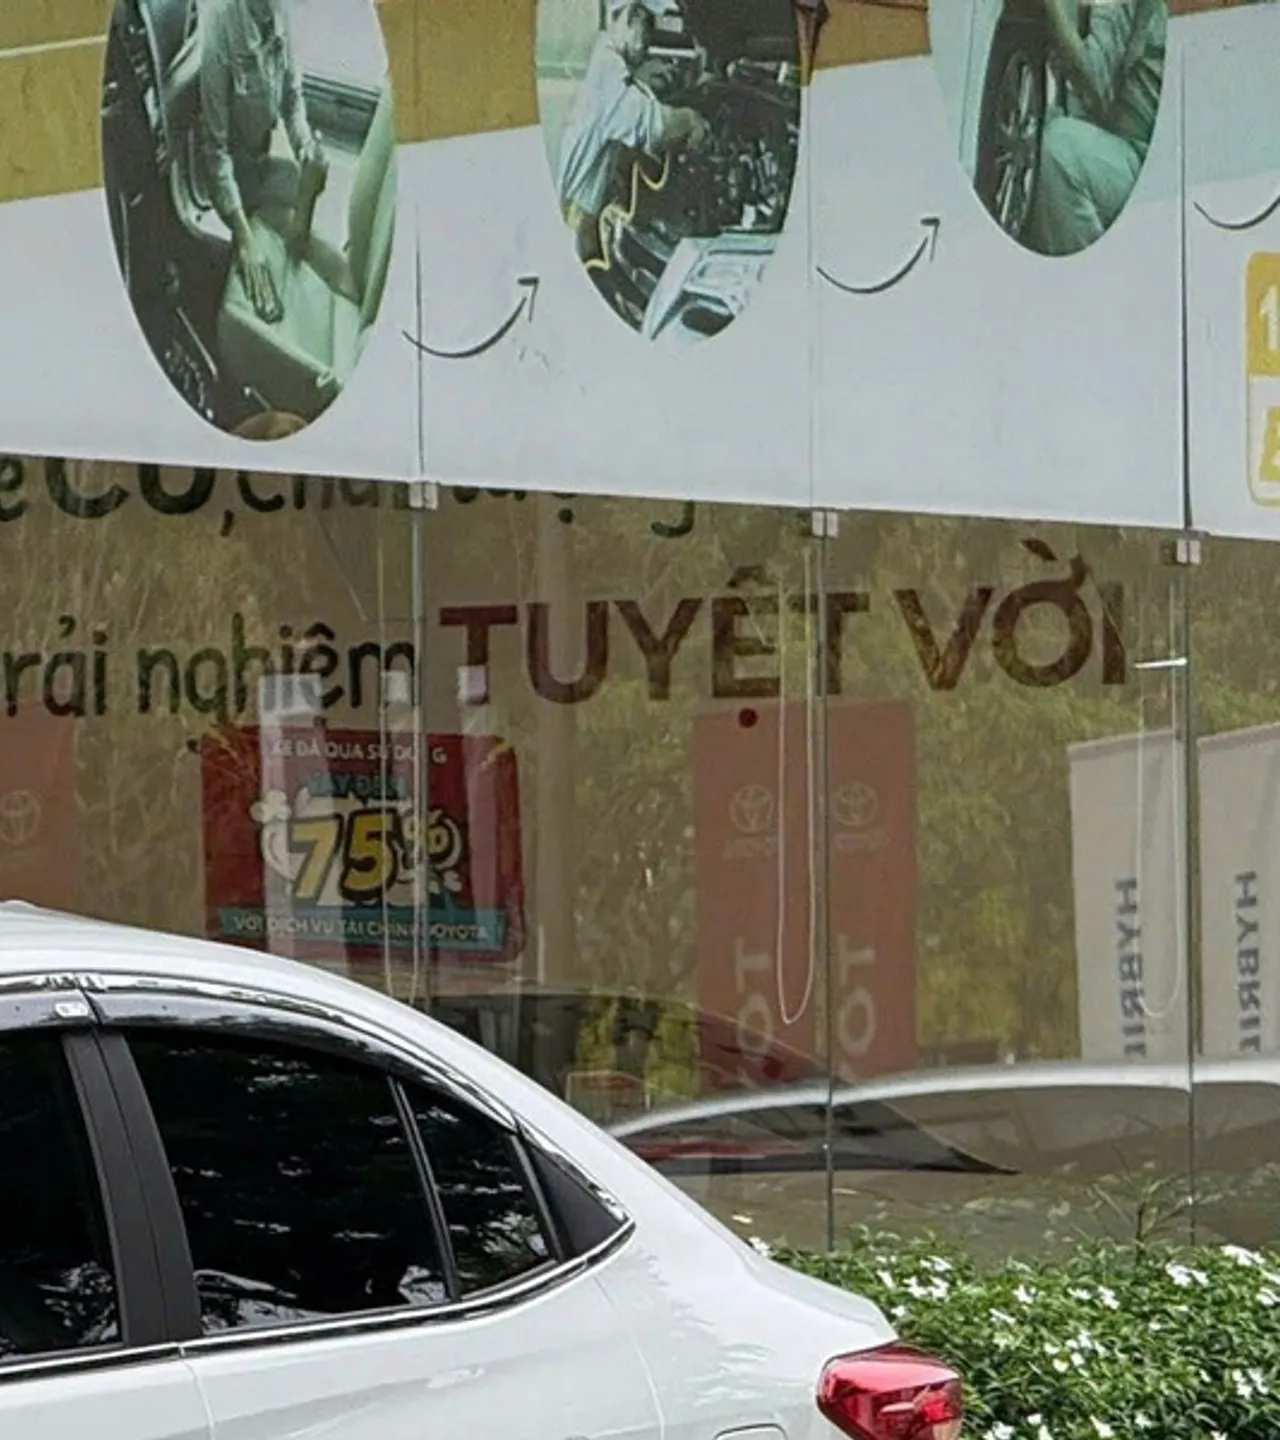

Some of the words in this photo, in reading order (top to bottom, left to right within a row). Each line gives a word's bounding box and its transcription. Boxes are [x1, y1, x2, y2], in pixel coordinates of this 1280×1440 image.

[137, 612, 416, 754] nghiệm
[440, 564, 870, 728] TUYỆT
[893, 538, 1126, 690] VỜI
